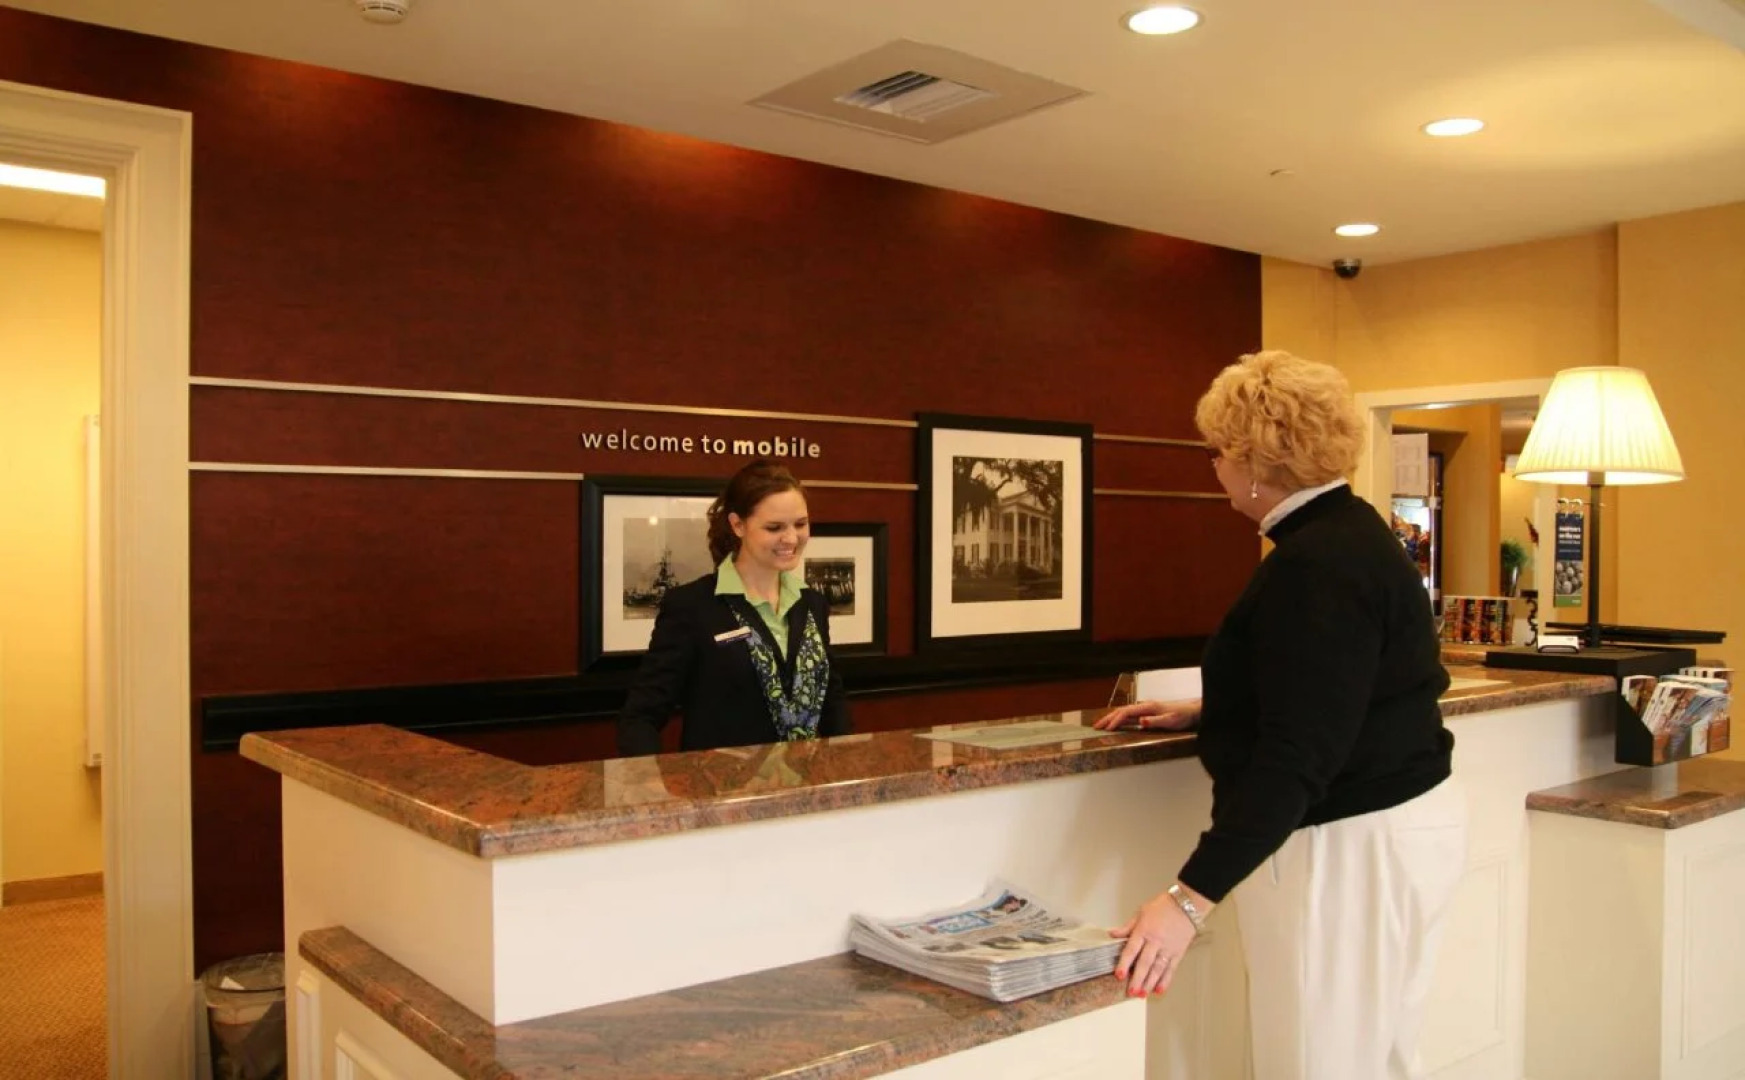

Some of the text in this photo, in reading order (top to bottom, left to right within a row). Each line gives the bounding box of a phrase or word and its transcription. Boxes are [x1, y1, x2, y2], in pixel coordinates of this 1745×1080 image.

[582, 428, 821, 458] welcome to mobile
